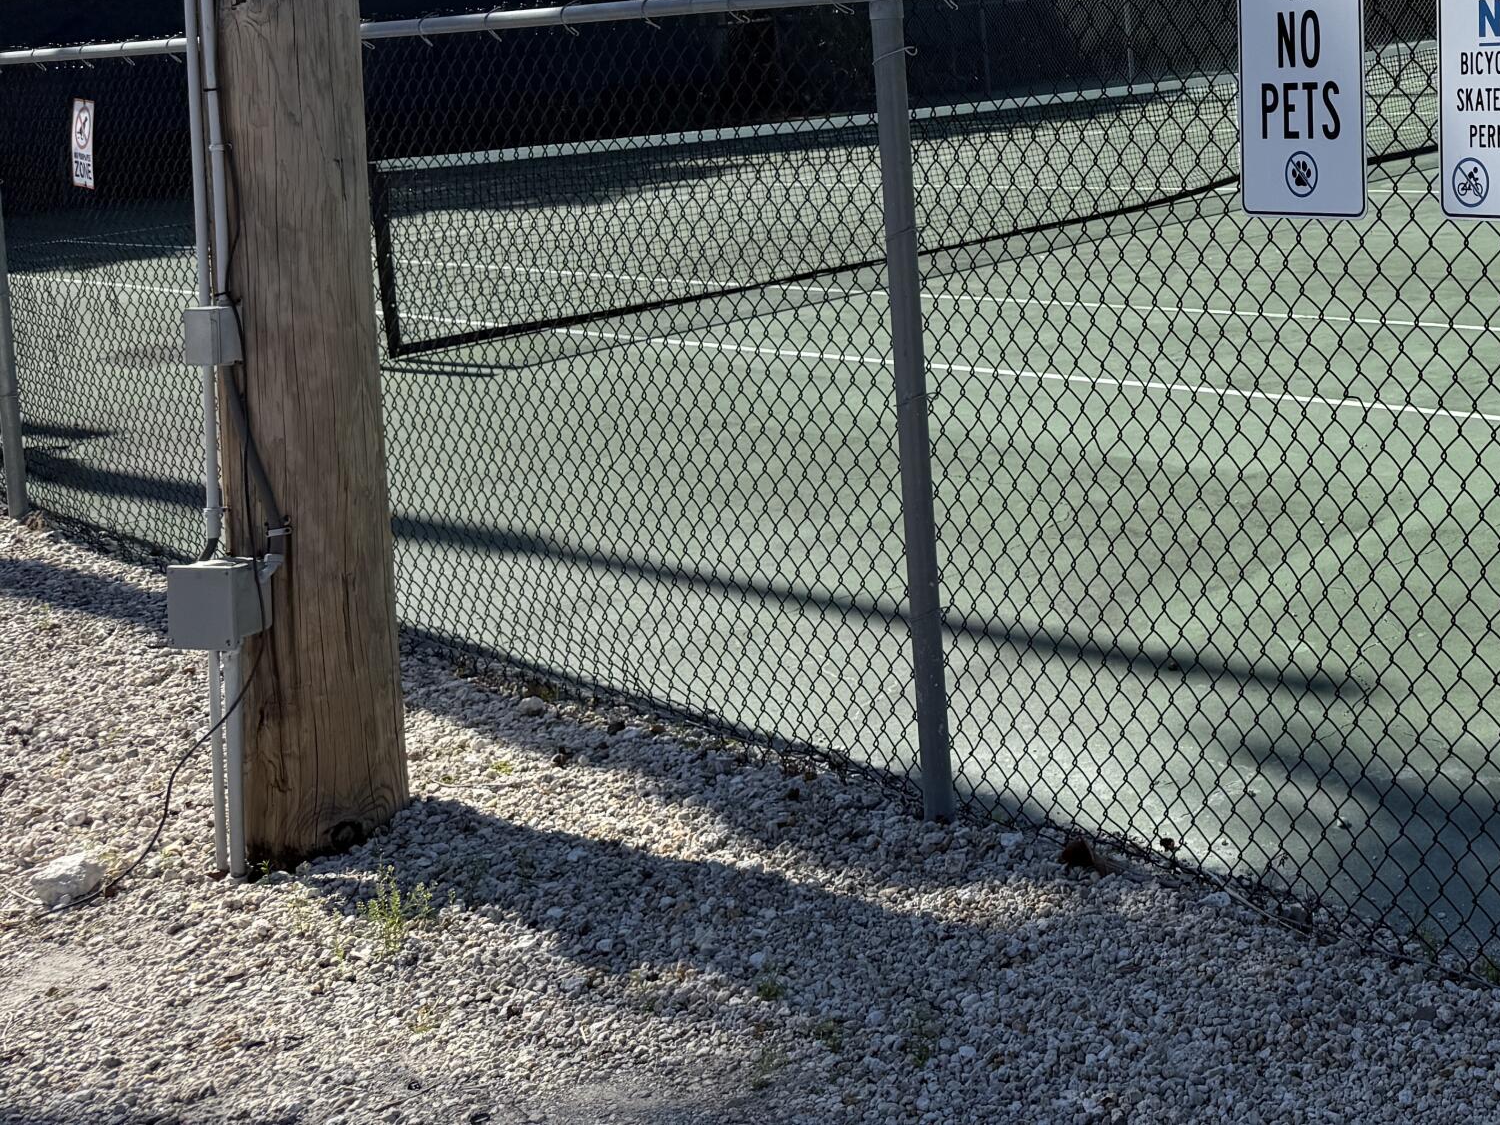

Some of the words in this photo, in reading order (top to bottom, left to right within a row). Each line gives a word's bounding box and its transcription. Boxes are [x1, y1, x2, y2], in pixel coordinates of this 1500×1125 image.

[1277, 9, 1321, 69] NO
[1261, 80, 1341, 140] PETS
[74, 160, 92, 180] ZONE
